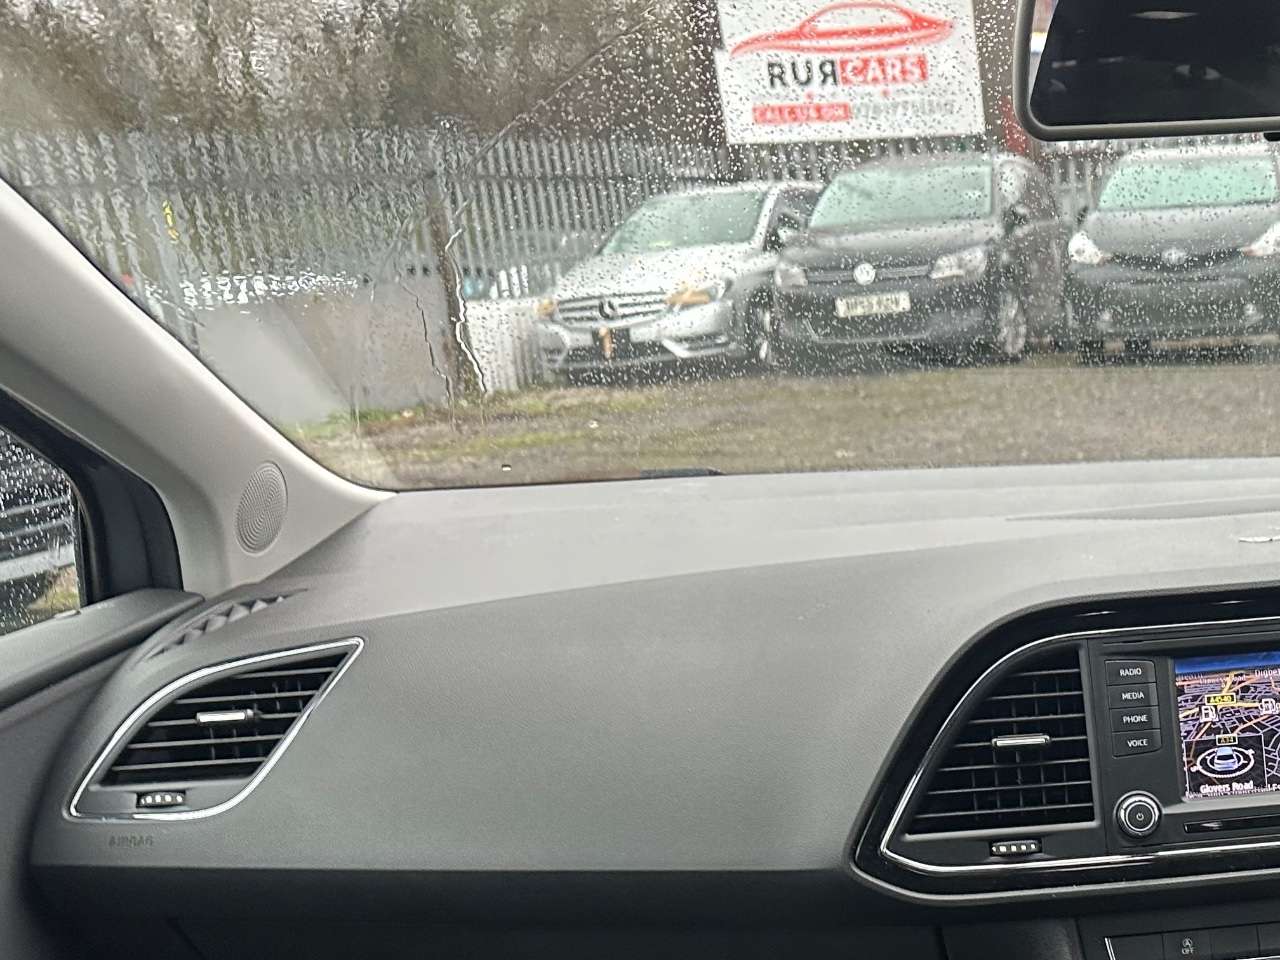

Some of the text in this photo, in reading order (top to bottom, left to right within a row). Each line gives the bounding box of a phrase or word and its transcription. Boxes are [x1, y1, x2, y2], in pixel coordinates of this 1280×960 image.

[1120, 668, 1141, 676] RADIO
[1122, 691, 1144, 700] MEDIA
[1123, 714, 1148, 723] PHONE
[1127, 739, 1148, 747] VOICE
[1200, 783, 1230, 794] Glovers
[1232, 780, 1254, 790] Road
